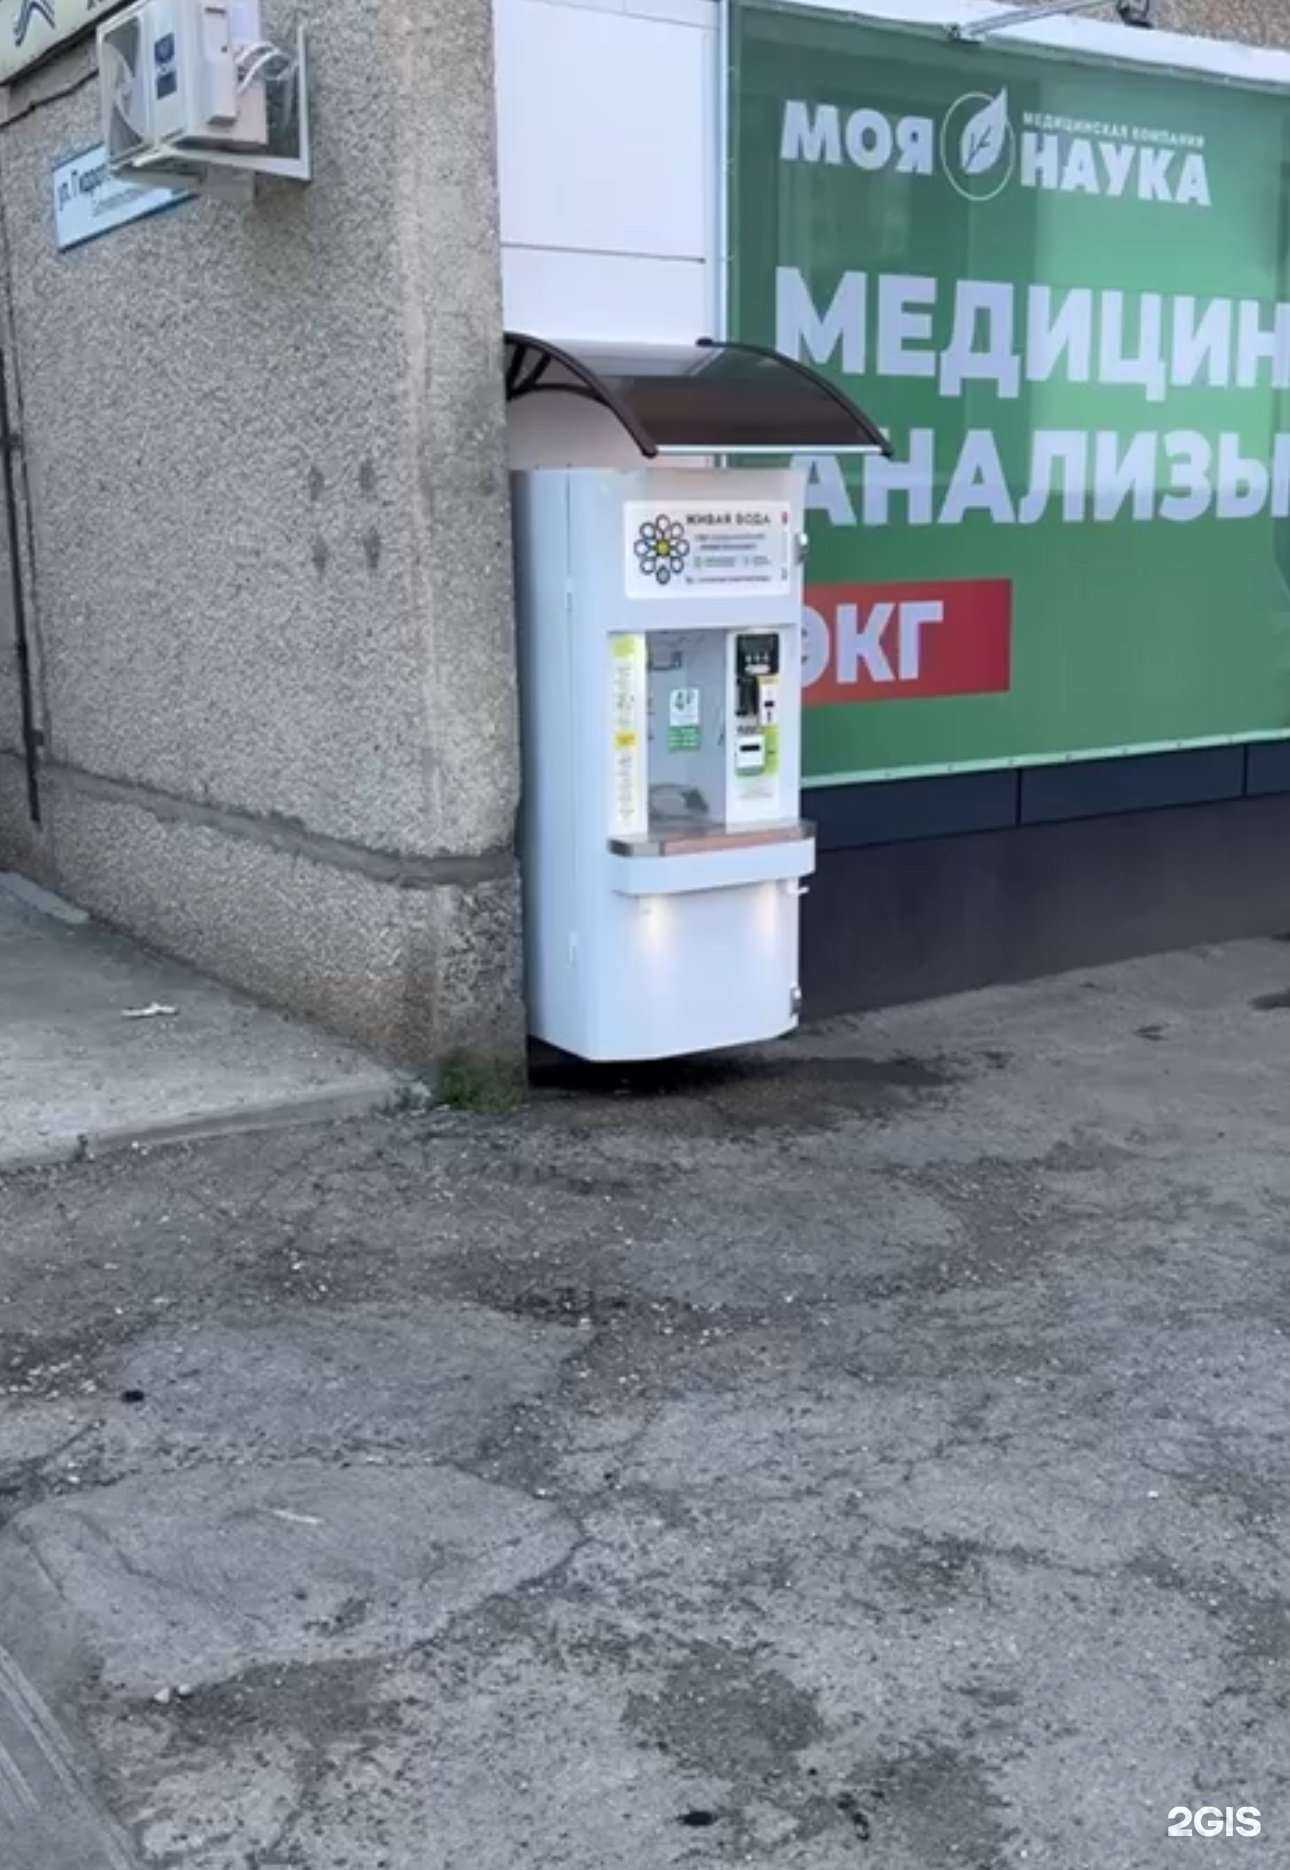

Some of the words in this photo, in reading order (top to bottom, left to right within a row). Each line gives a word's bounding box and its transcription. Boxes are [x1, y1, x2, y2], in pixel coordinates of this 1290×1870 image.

[781, 100, 934, 175] МОЯ
[1023, 112, 1128, 139] МЕДИЦИНСКАЯ
[1020, 131, 1212, 206] НАУКА
[775, 266, 1290, 402] МЕДИЦИН
[789, 427, 1290, 526] АНАЛИЗЫ
[686, 513, 732, 525] ЖИВАЯ
[735, 512, 771, 525] ВОДА
